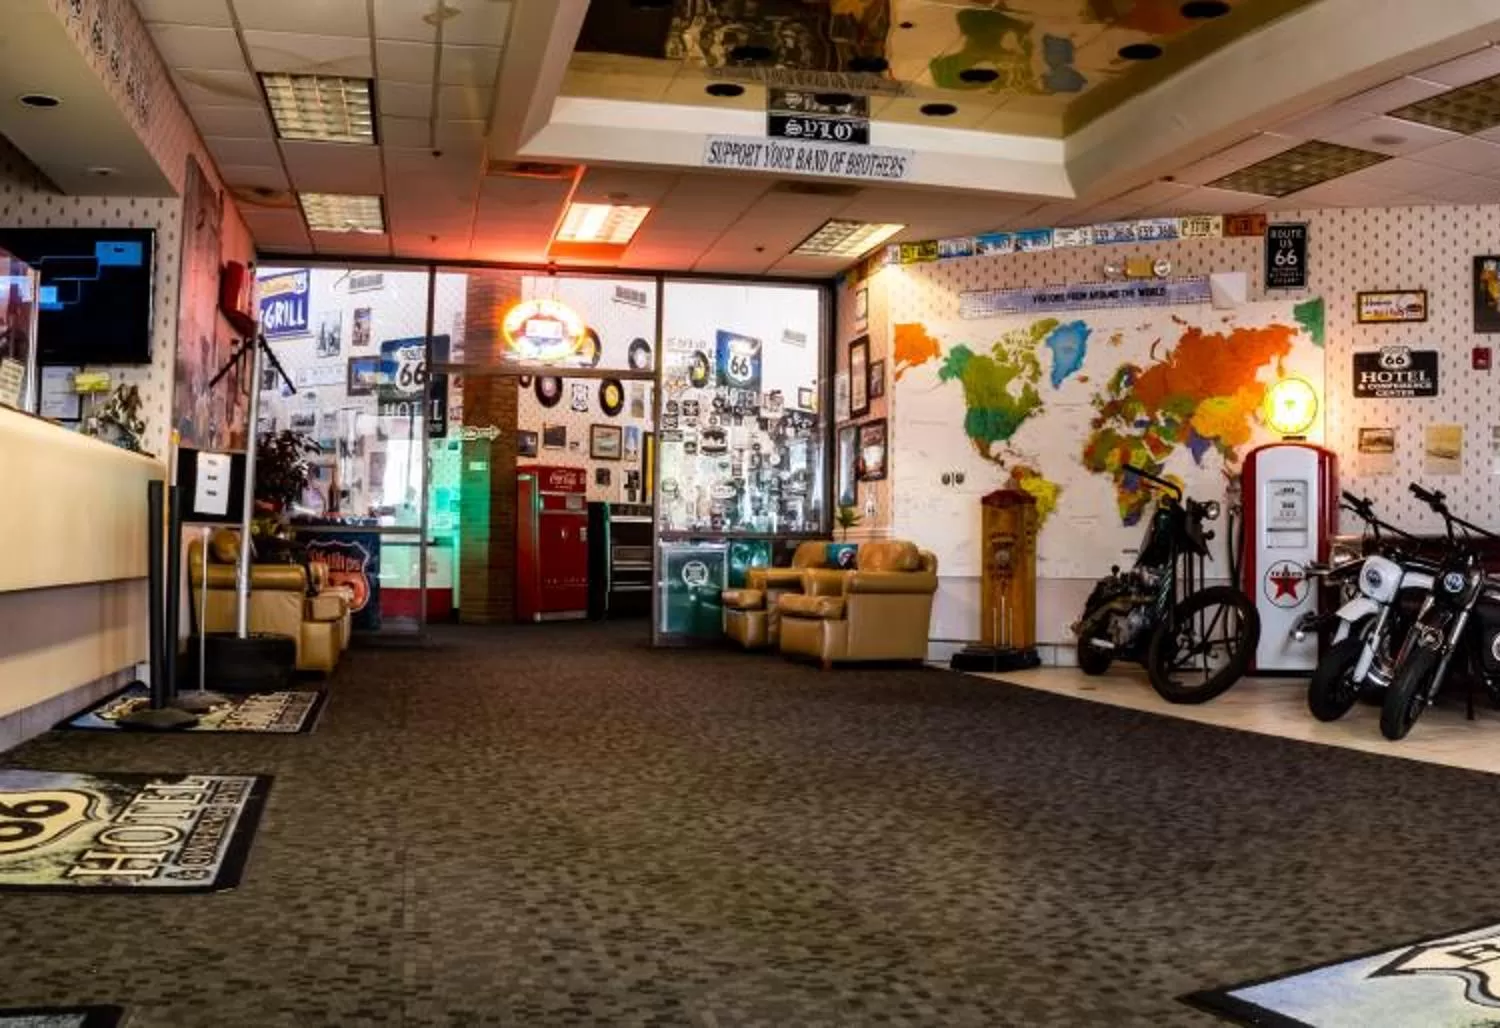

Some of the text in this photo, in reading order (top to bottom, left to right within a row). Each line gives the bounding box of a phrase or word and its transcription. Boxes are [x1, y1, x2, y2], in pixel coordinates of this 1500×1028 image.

[708, 141, 906, 177] SUPPORT YOUR BAND OF BROTHERS
[1275, 249, 1297, 265] 66
[264, 298, 305, 329] GRILL
[731, 356, 748, 376] 66
[1385, 356, 1405, 365] 66
[400, 362, 427, 386] 66
[1361, 371, 1431, 383] HOTEL
[64, 776, 211, 880] HOTEL
